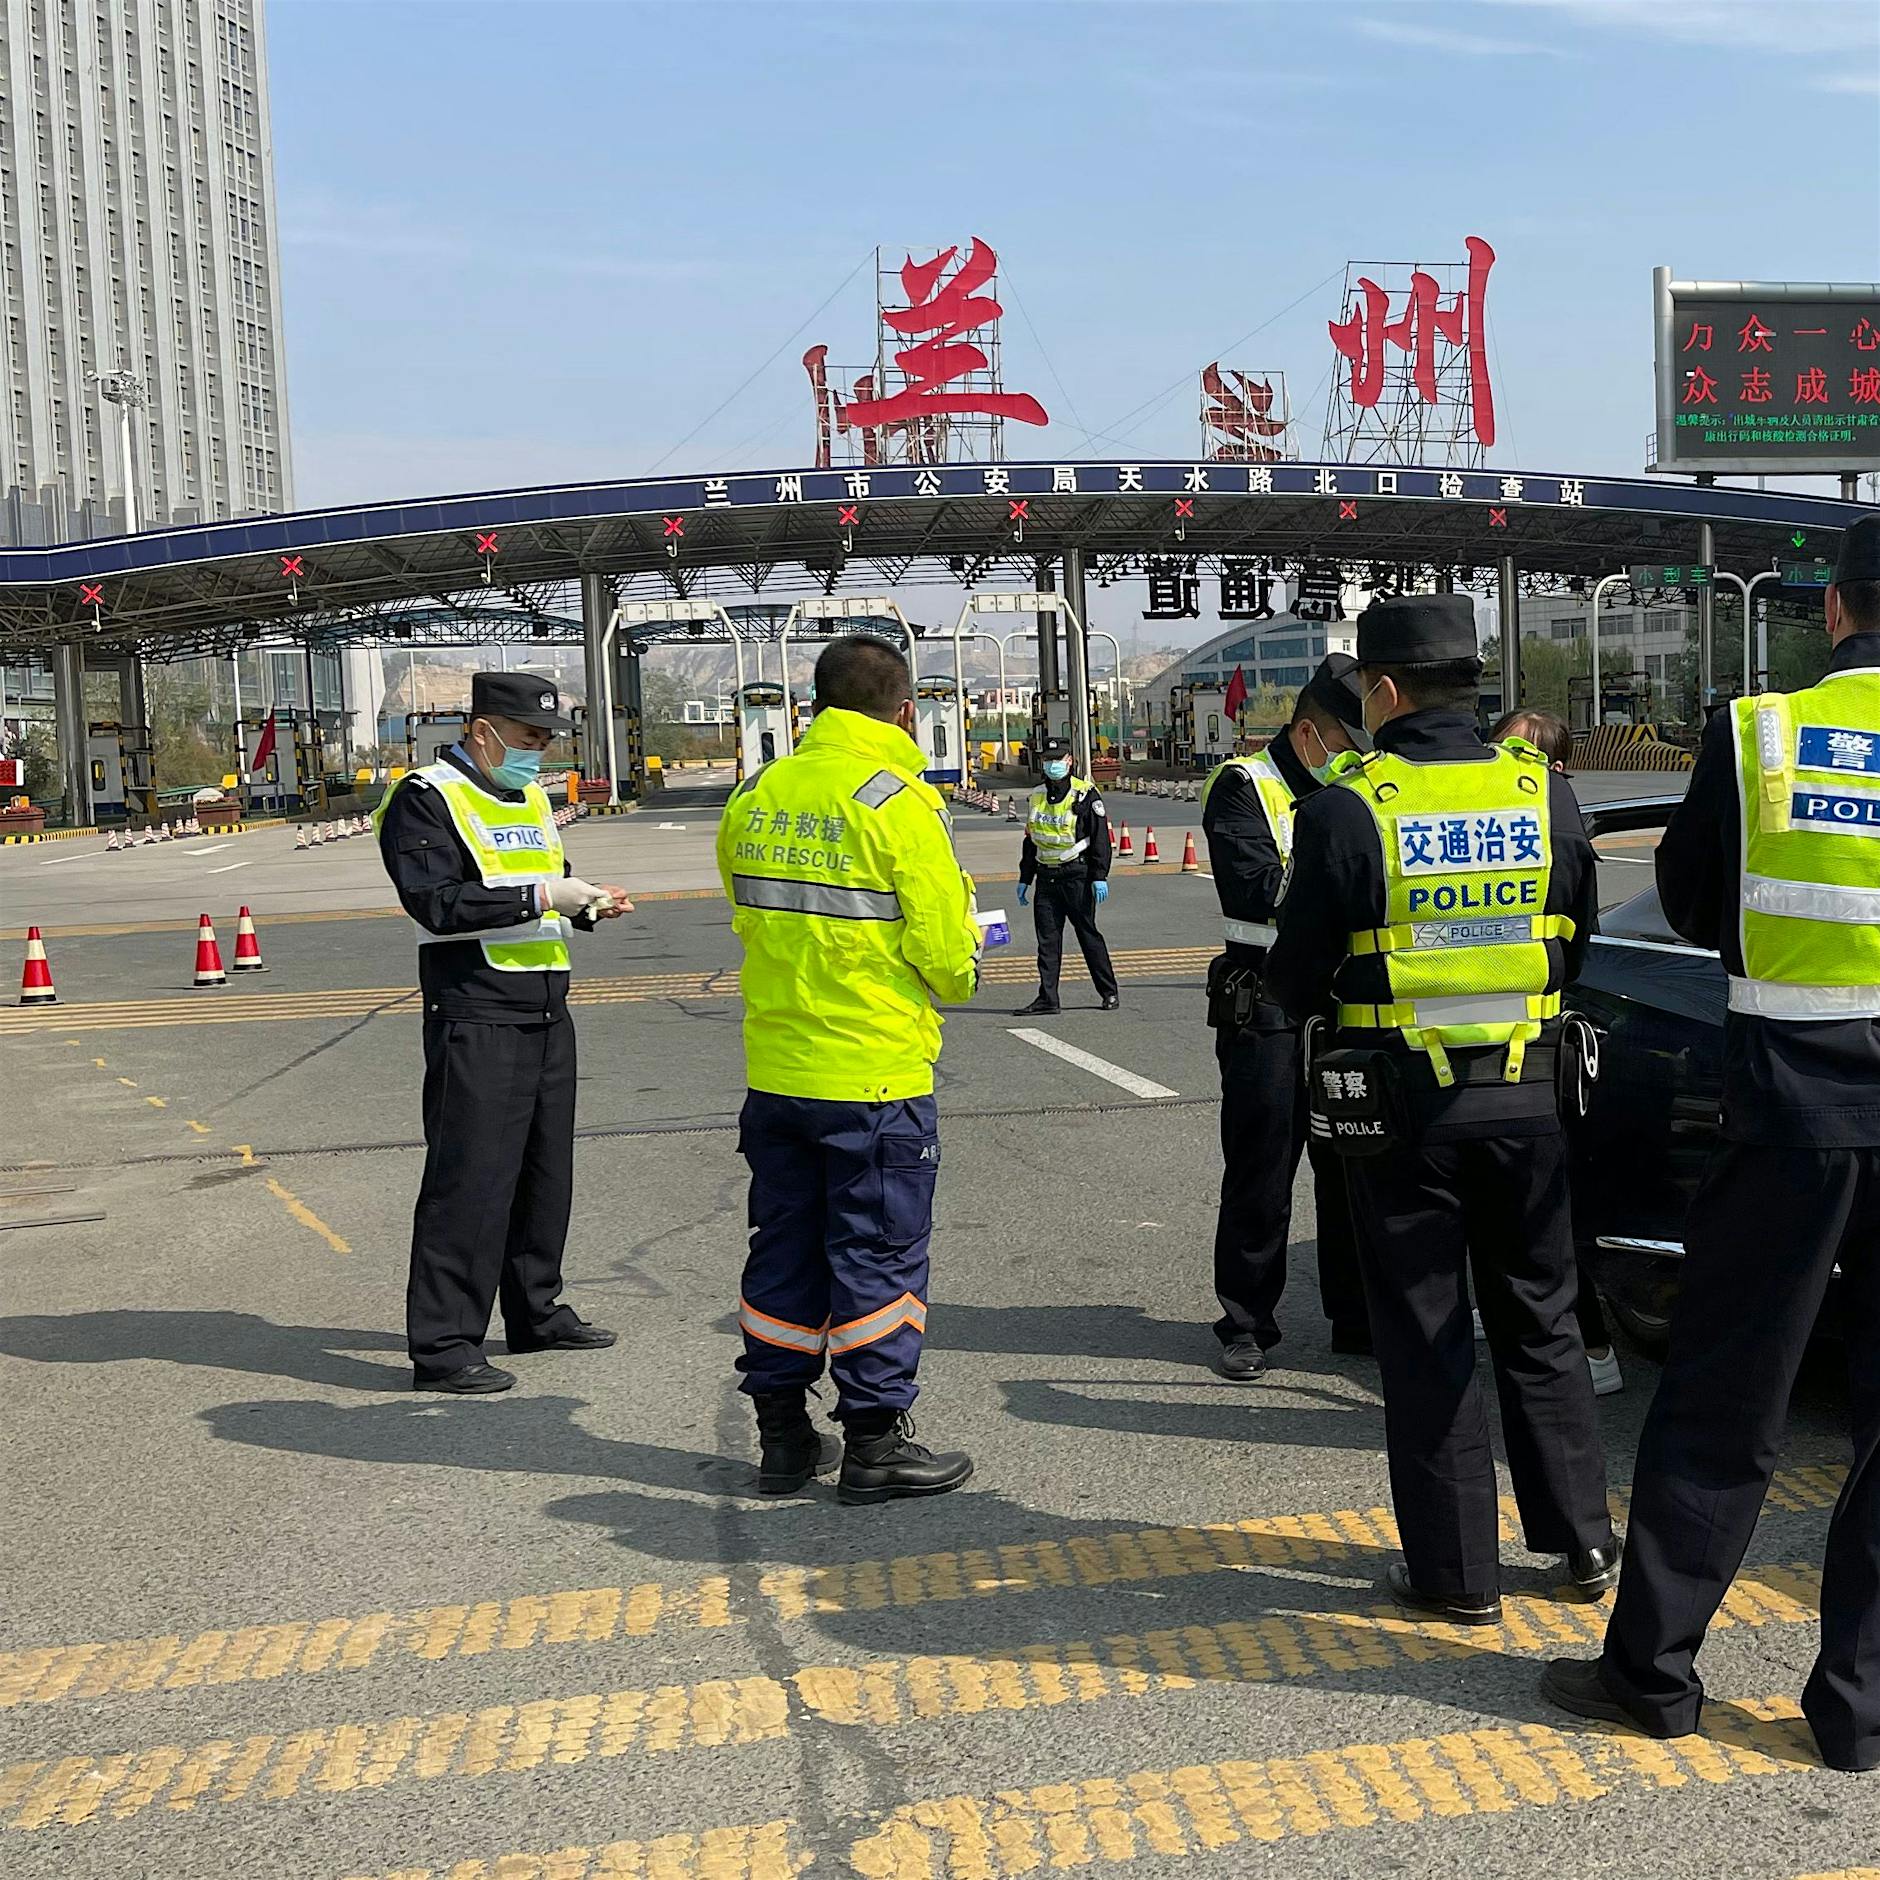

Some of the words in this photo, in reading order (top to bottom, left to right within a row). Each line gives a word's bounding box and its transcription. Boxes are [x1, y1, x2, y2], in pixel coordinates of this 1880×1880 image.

[1682, 365, 1880, 405] 众志成城
[703, 466, 1585, 508] 兰州市公安局天水路北口检查站
[1637, 566, 1709, 586] 小型车
[1826, 731, 1873, 769] 警
[494, 830, 545, 846] POLIC
[744, 807, 846, 843] 方舟救援
[735, 841, 768, 861] ARK
[772, 846, 854, 872] RESCUE
[1401, 816, 1541, 867] 交通治安
[1409, 880, 1537, 912] POLICE
[1451, 924, 1503, 938] POLICE
[1321, 1071, 1367, 1099] 警察
[1336, 1121, 1384, 1135] POLICE
